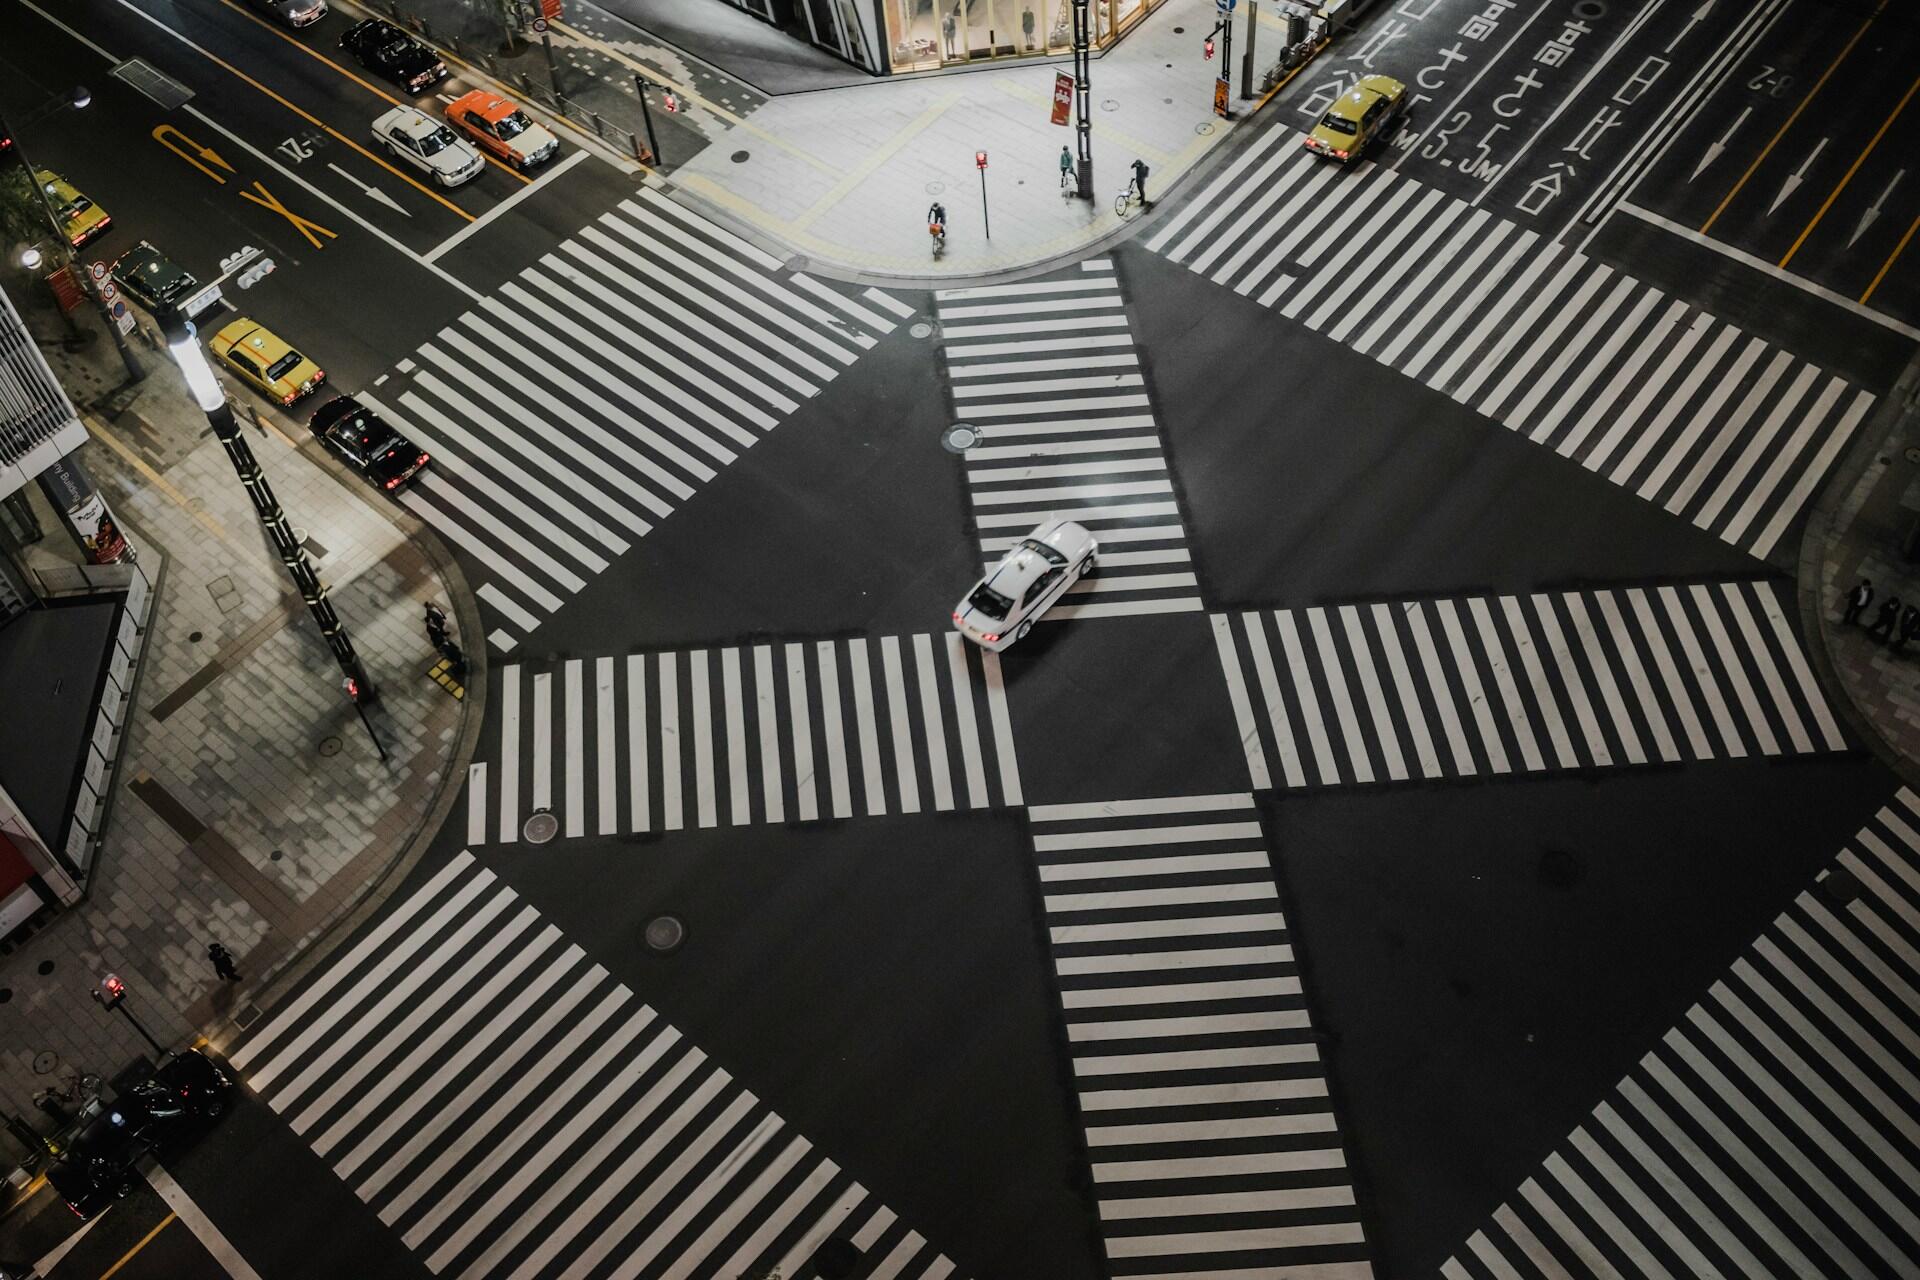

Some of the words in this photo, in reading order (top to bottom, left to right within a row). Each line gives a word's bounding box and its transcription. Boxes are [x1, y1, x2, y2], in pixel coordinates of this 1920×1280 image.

[1416, 0, 1518, 90] 高さ
[1491, 20, 1593, 118] 高さ
[1420, 111, 1511, 183] 3.5M
[1515, 55, 1671, 216] 日比谷
[60, 472, 81, 503] Building
